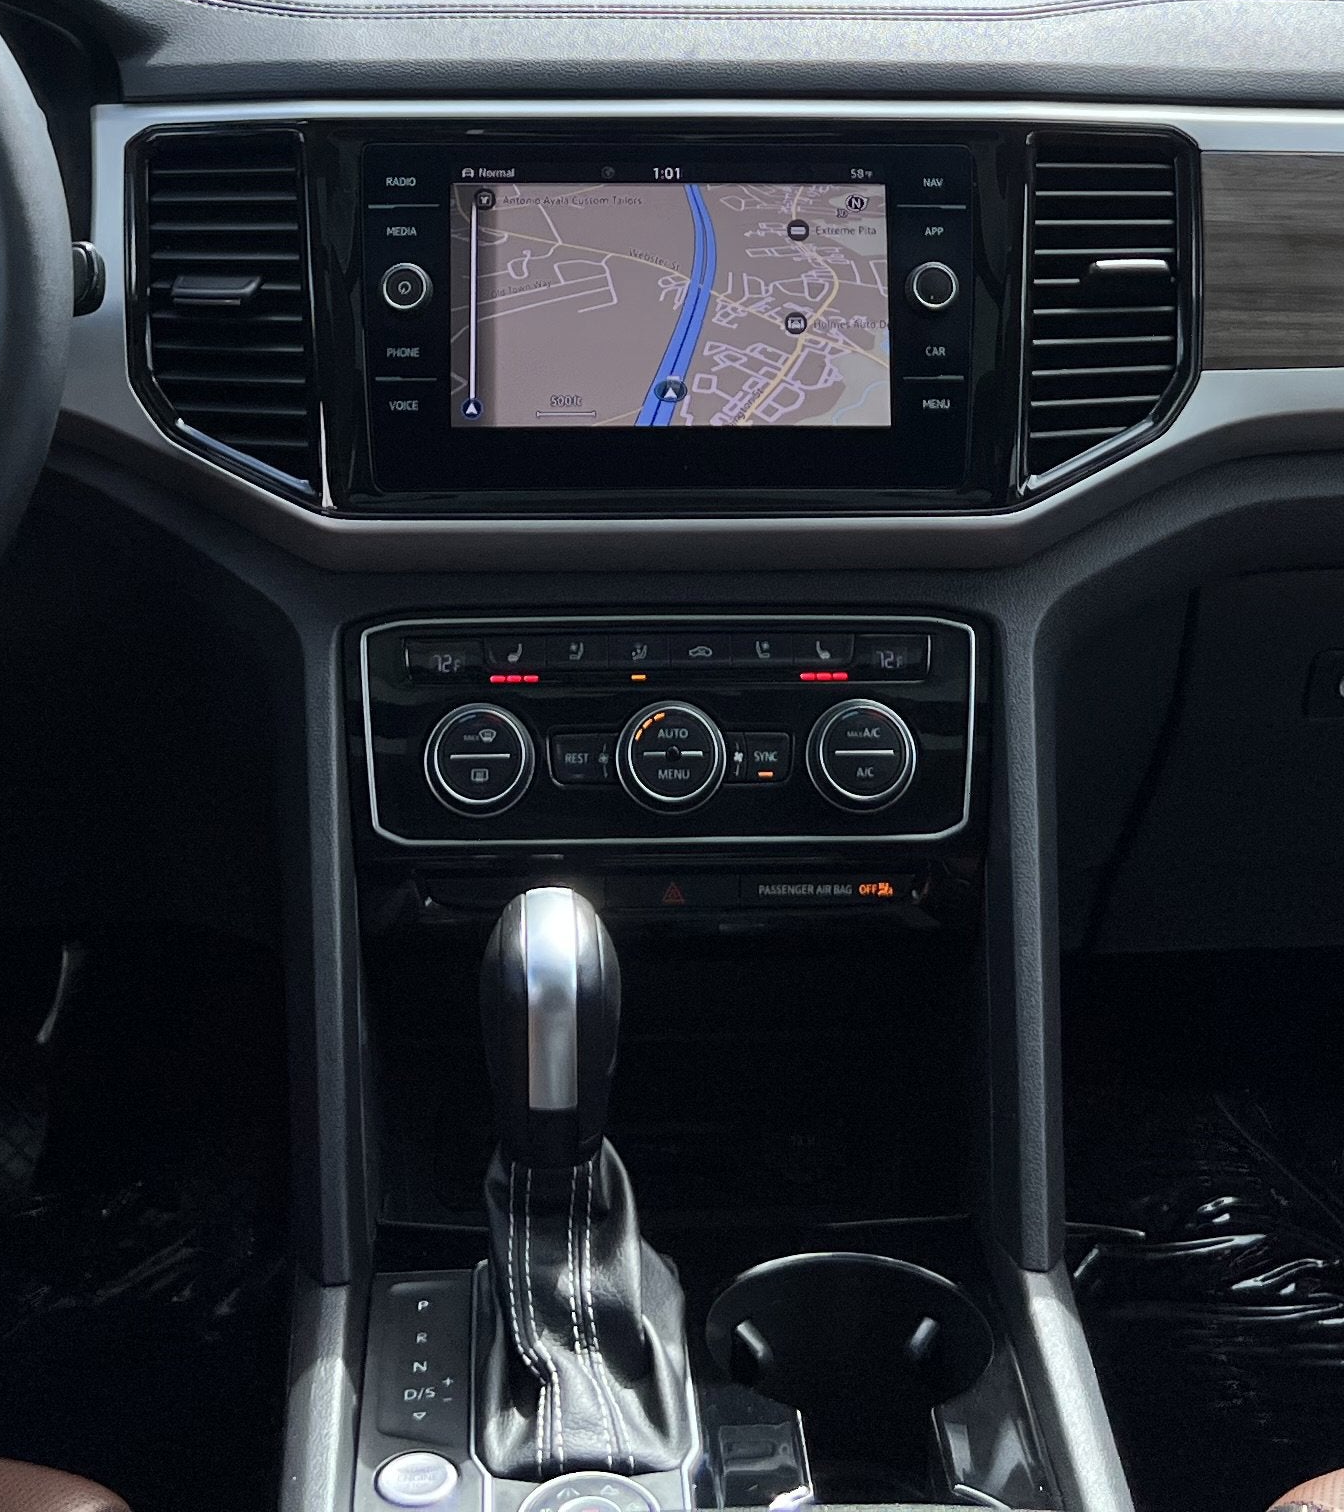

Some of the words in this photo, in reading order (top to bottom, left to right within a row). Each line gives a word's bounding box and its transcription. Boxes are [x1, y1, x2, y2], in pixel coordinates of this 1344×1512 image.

[478, 167, 515, 178] Normal
[652, 166, 681, 180] 1:01
[385, 177, 416, 187] RADIO
[923, 178, 944, 188] NAV
[543, 196, 569, 207] Ayala
[386, 226, 417, 237] MEDIA
[815, 225, 856, 236] Extreme
[858, 225, 877, 236] Pita
[924, 227, 944, 237] APP
[490, 287, 506, 299] Old
[386, 347, 420, 358] PHONE
[925, 346, 945, 357] CAR
[389, 399, 419, 411] VOICE
[922, 398, 950, 409] MENU
[657, 728, 689, 739] AUTO
[564, 753, 589, 764] REST
[753, 751, 778, 763] SYNC
[657, 769, 691, 780] MENU
[856, 766, 875, 778] A/C
[758, 884, 814, 895] PASSENGER
[816, 884, 833, 895] AIR
[833, 884, 853, 895] BAG
[858, 884, 877, 896] OFF
[417, 1299, 429, 1312] P
[416, 1332, 427, 1344] R
[413, 1360, 428, 1373] N
[403, 1386, 436, 1402] D/S
